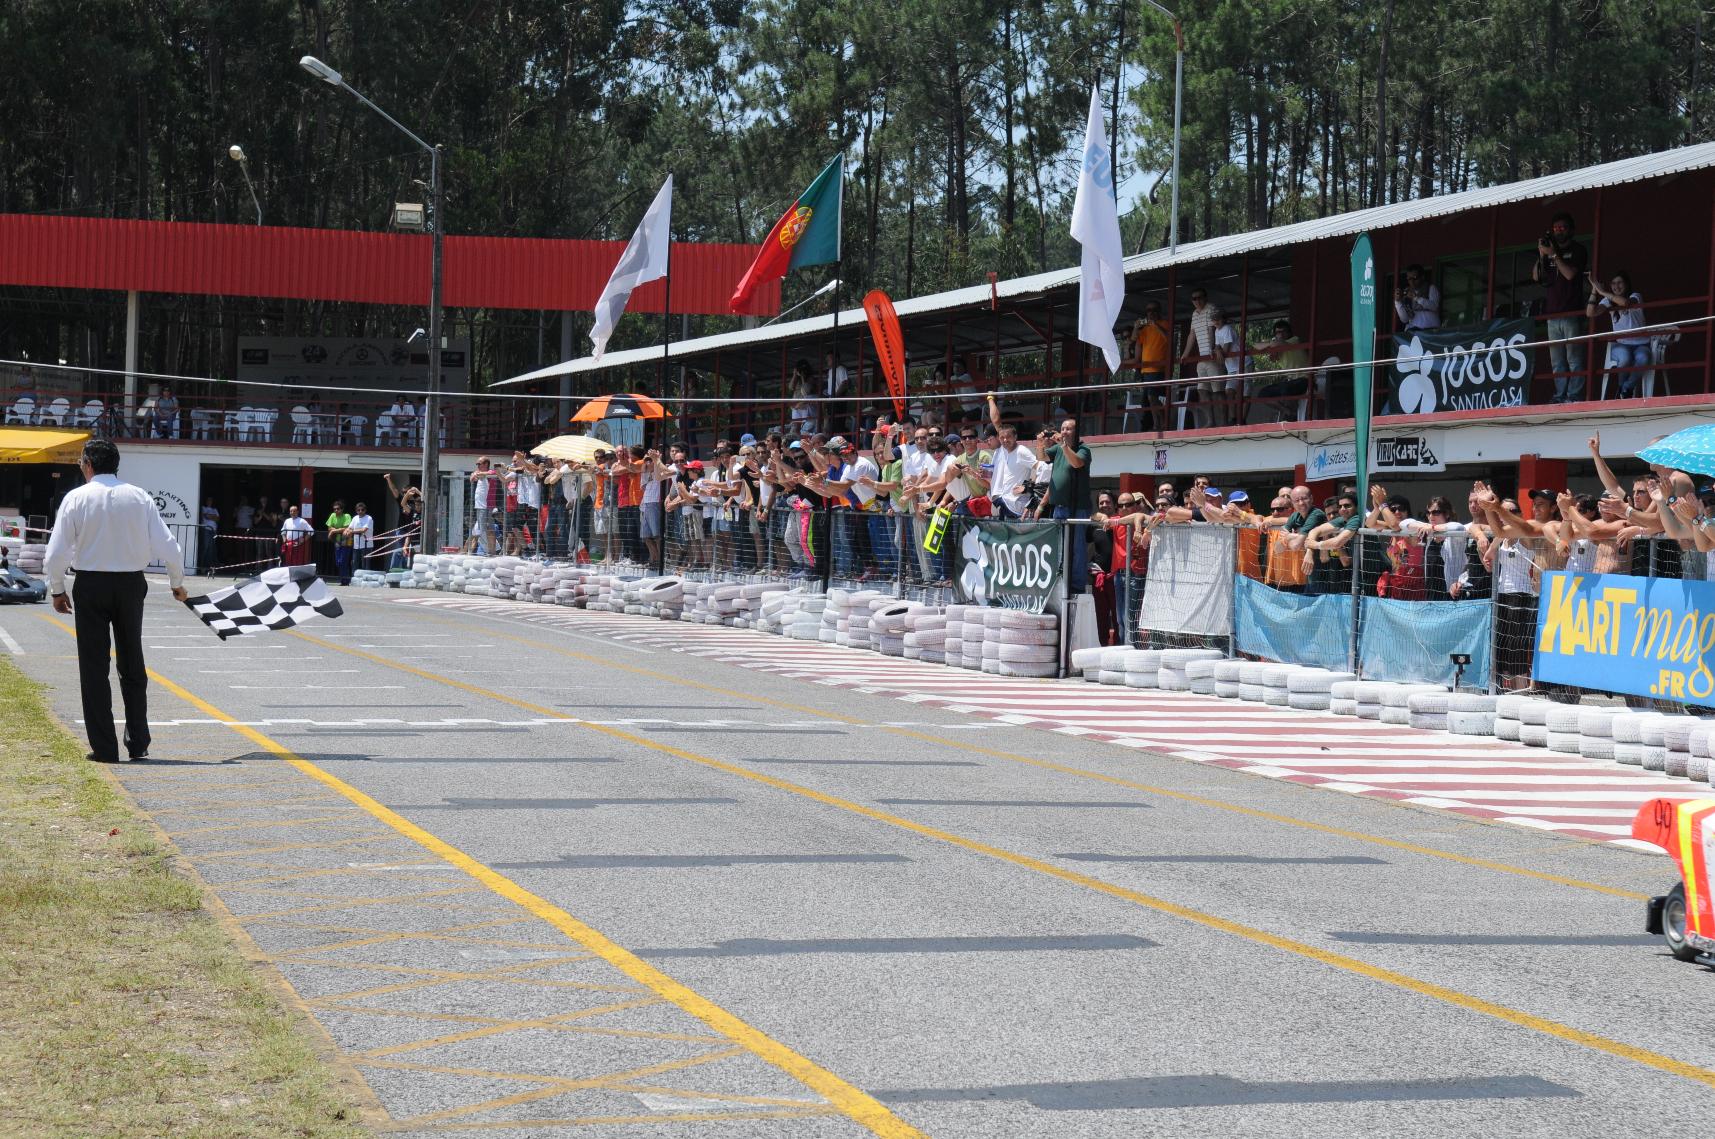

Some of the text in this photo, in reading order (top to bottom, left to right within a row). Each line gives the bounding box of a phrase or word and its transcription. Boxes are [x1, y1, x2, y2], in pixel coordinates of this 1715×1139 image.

[1441, 333, 1527, 406] JOGOS
[1450, 386, 1523, 411] SANTACASA
[158, 490, 191, 519] KARTING
[990, 542, 1052, 599] JOGOS
[1539, 575, 1715, 698] KART mag
[1650, 669, 1686, 698] .FR
